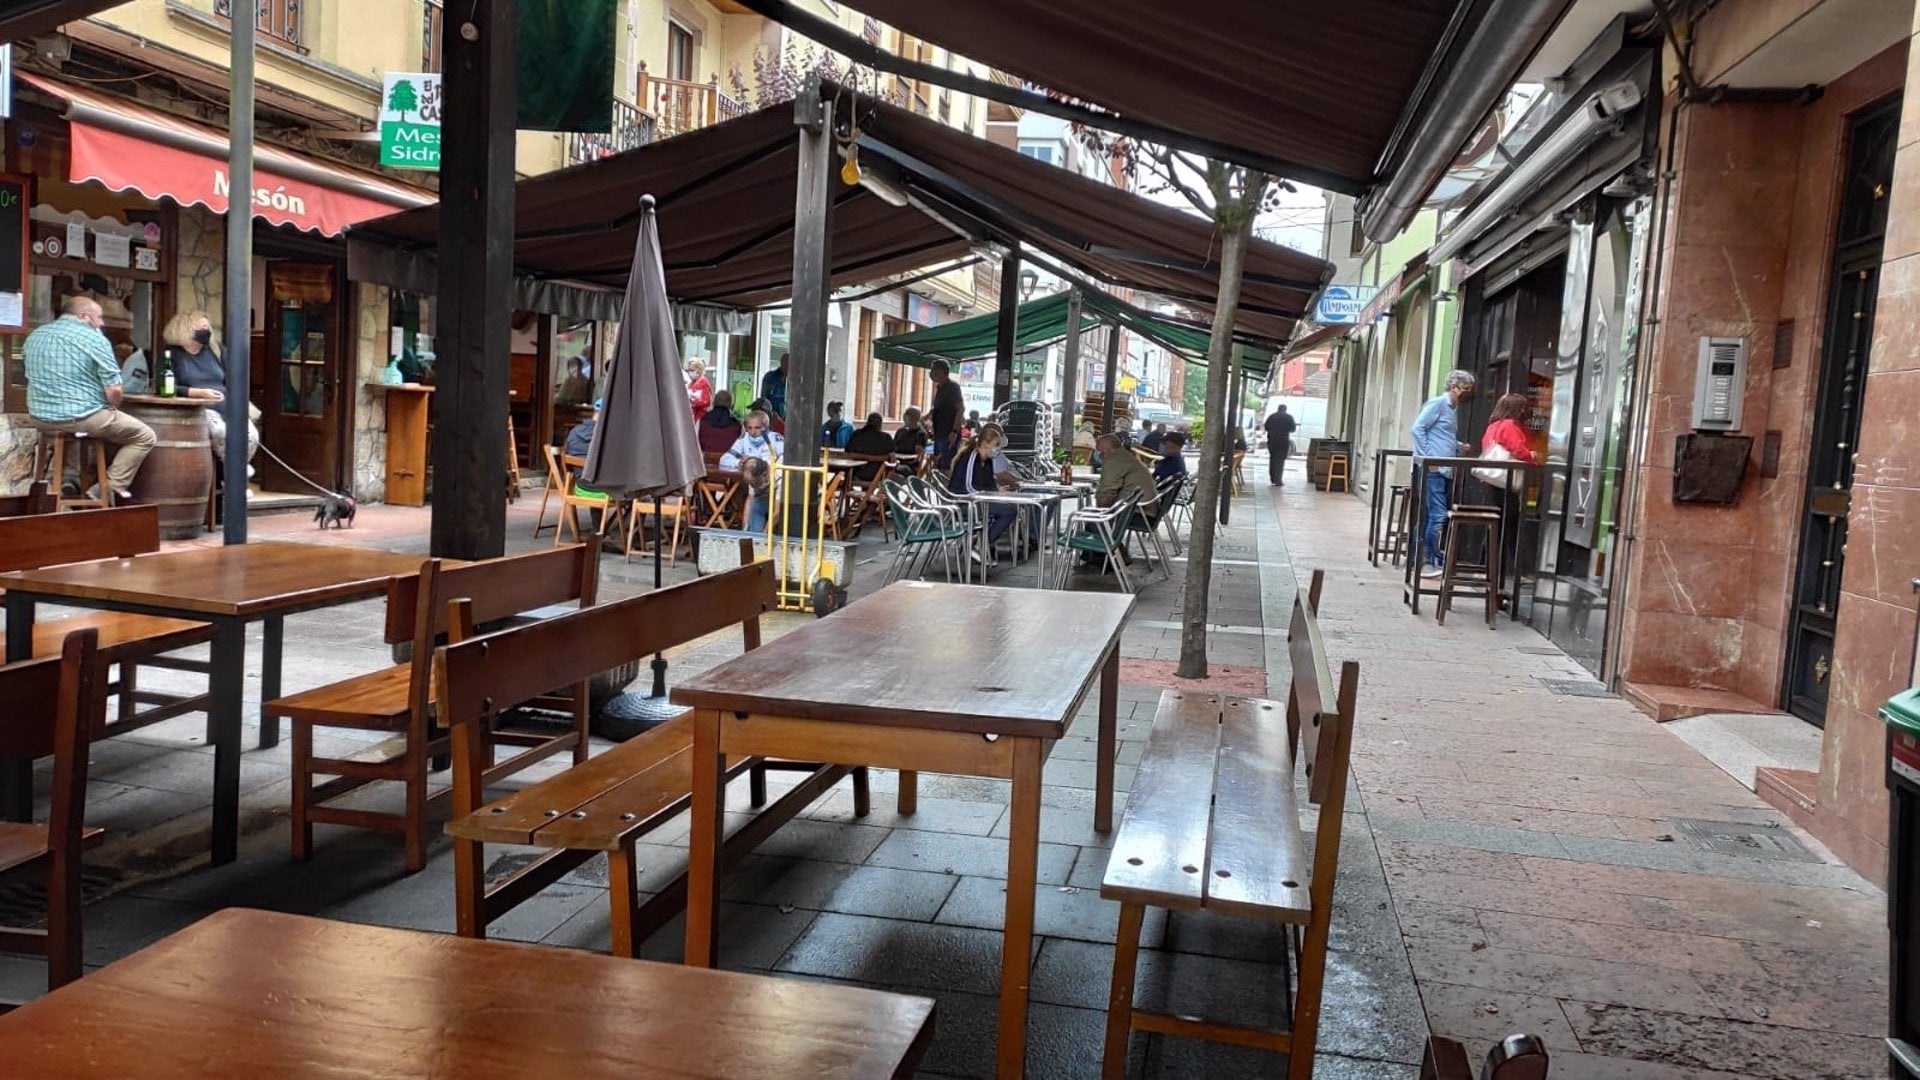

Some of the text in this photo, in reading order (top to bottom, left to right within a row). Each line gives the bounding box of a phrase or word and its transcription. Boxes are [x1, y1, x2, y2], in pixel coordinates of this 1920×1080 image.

[420, 105, 441, 121] CA
[390, 145, 440, 161] Sidr
[213, 169, 305, 215] Msón
